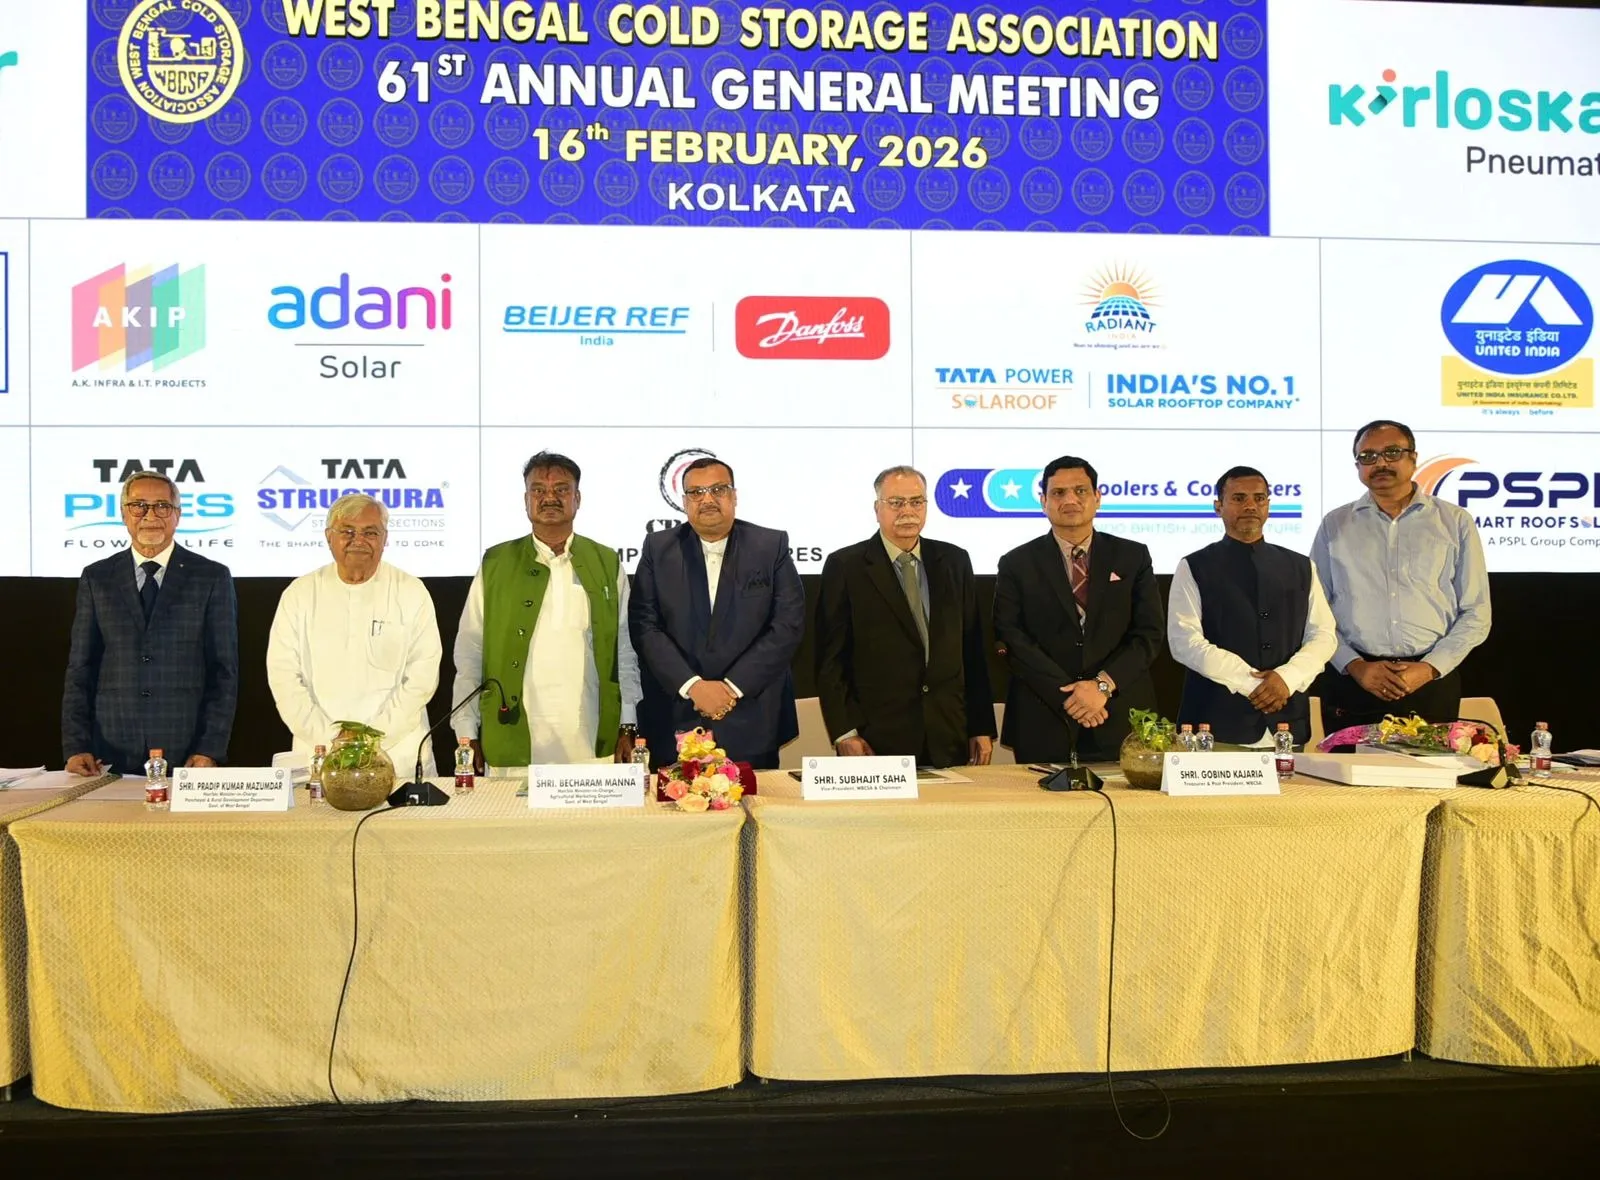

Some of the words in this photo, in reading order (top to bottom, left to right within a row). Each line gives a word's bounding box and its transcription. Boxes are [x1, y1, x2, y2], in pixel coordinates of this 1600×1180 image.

[132, 0, 176, 40] BENGAL
[182, 0, 217, 23] COLD
[284, 0, 395, 39] WEST
[416, 2, 588, 43] BENGAL
[608, 4, 720, 46] COLD
[740, 8, 928, 51] STORAGE
[947, 13, 1218, 61] ASSOCIATION
[129, 43, 143, 79] WEST
[214, 24, 232, 85] STORAGE
[138, 81, 220, 113] ASSOCIATION
[480, 63, 696, 109] ANNUAL
[711, 67, 933, 115] GENERAL
[948, 74, 1160, 121] MEETING
[532, 123, 609, 162] 16th
[625, 130, 864, 172] FEBRUARY,
[878, 135, 988, 168] 2026
[668, 183, 855, 213] KOLKATA
[267, 272, 452, 330] adani
[92, 306, 187, 328] AKIP
[503, 305, 616, 326] BEIJER
[625, 306, 690, 327] REF
[1085, 318, 1156, 333] RADIANT
[756, 307, 864, 348] Danfoss
[580, 335, 614, 346] India
[1475, 345, 1521, 356] UNITED
[1525, 346, 1560, 357] INDIA
[319, 355, 402, 379] Solar
[935, 368, 996, 383] TATA
[1005, 369, 1073, 383] POWER
[72, 379, 91, 387] A.K.
[94, 379, 126, 387] INFRA
[128, 379, 136, 387] &
[155, 379, 207, 387] PROJECTS
[1107, 374, 1217, 395] INDIA'S
[952, 394, 1057, 409] SOLAROOF
[1108, 398, 1154, 408] SOLAR
[1158, 398, 1223, 408] ROOFTOP
[93, 459, 205, 483] TATA
[321, 459, 407, 479] TATA
[257, 488, 445, 509] STRUURA
[1100, 480, 1159, 497] oolers
[1164, 481, 1177, 496] &
[1458, 472, 1600, 508] PSP
[64, 493, 235, 518] PIES
[389, 519, 445, 528] SECTIONS
[1191, 523, 1223, 534] JOIN
[1267, 523, 1301, 534] TURE
[1475, 516, 1515, 528] MART
[64, 539, 128, 548] FLOW
[185, 539, 234, 548] LIFE
[1488, 537, 1495, 545] A
[1499, 537, 1526, 546] PSPL
[1530, 536, 1566, 547] Group
[536, 779, 557, 788] SHRI.
[559, 779, 603, 787] BECHARAM
[605, 778, 636, 787] MANNA
[814, 776, 836, 784] SHRI.
[839, 775, 880, 784] SUBHAJIT
[882, 774, 907, 783] SAHA
[1180, 770, 1199, 779] SHRI.
[1201, 770, 1231, 779] GOBIND
[1233, 770, 1263, 778] KAJARIA
[179, 781, 195, 790] SHRI.
[197, 782, 220, 790] PRADIP
[221, 782, 245, 790] KUMAR
[246, 781, 283, 790] MAZUMDAR
